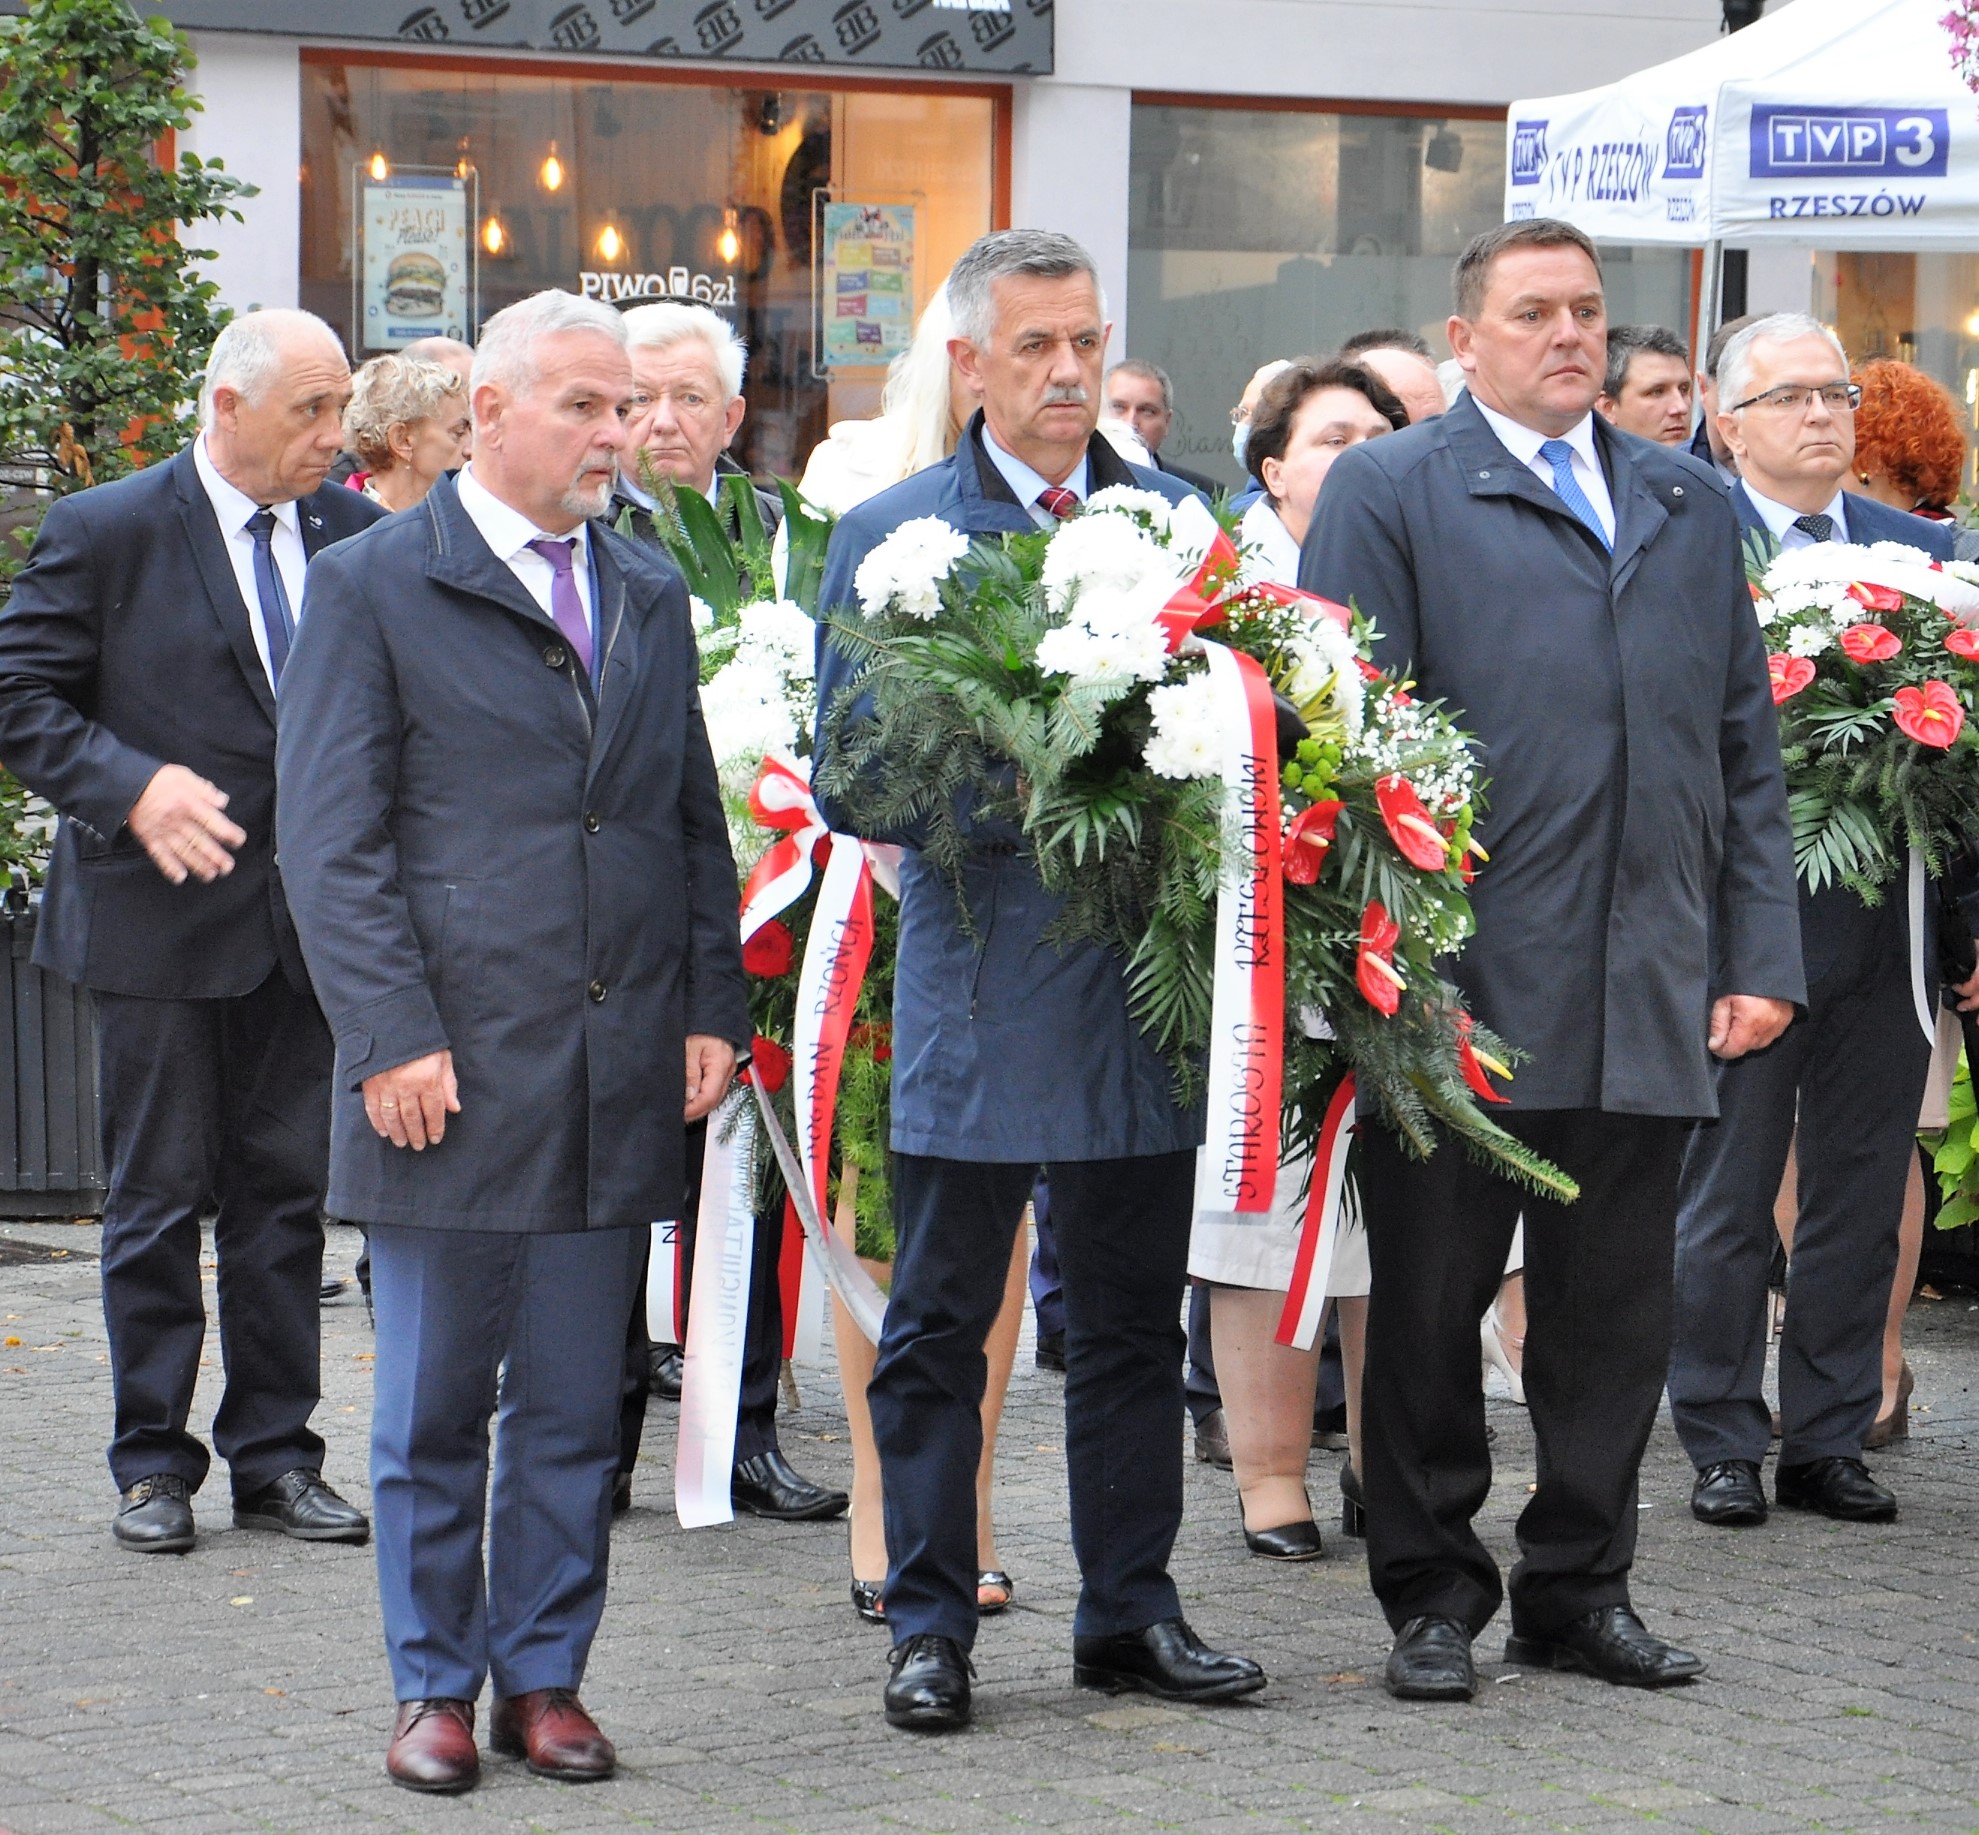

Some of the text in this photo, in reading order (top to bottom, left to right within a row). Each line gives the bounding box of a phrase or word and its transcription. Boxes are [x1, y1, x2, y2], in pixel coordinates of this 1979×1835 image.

[1586, 124, 1659, 204] RZESZÓW
[1774, 116, 1936, 167] TVP 3
[1769, 187, 1927, 220] RZESZÓW
[579, 271, 667, 299] PIWO
[1222, 1022, 1268, 1200] STAROSTA
